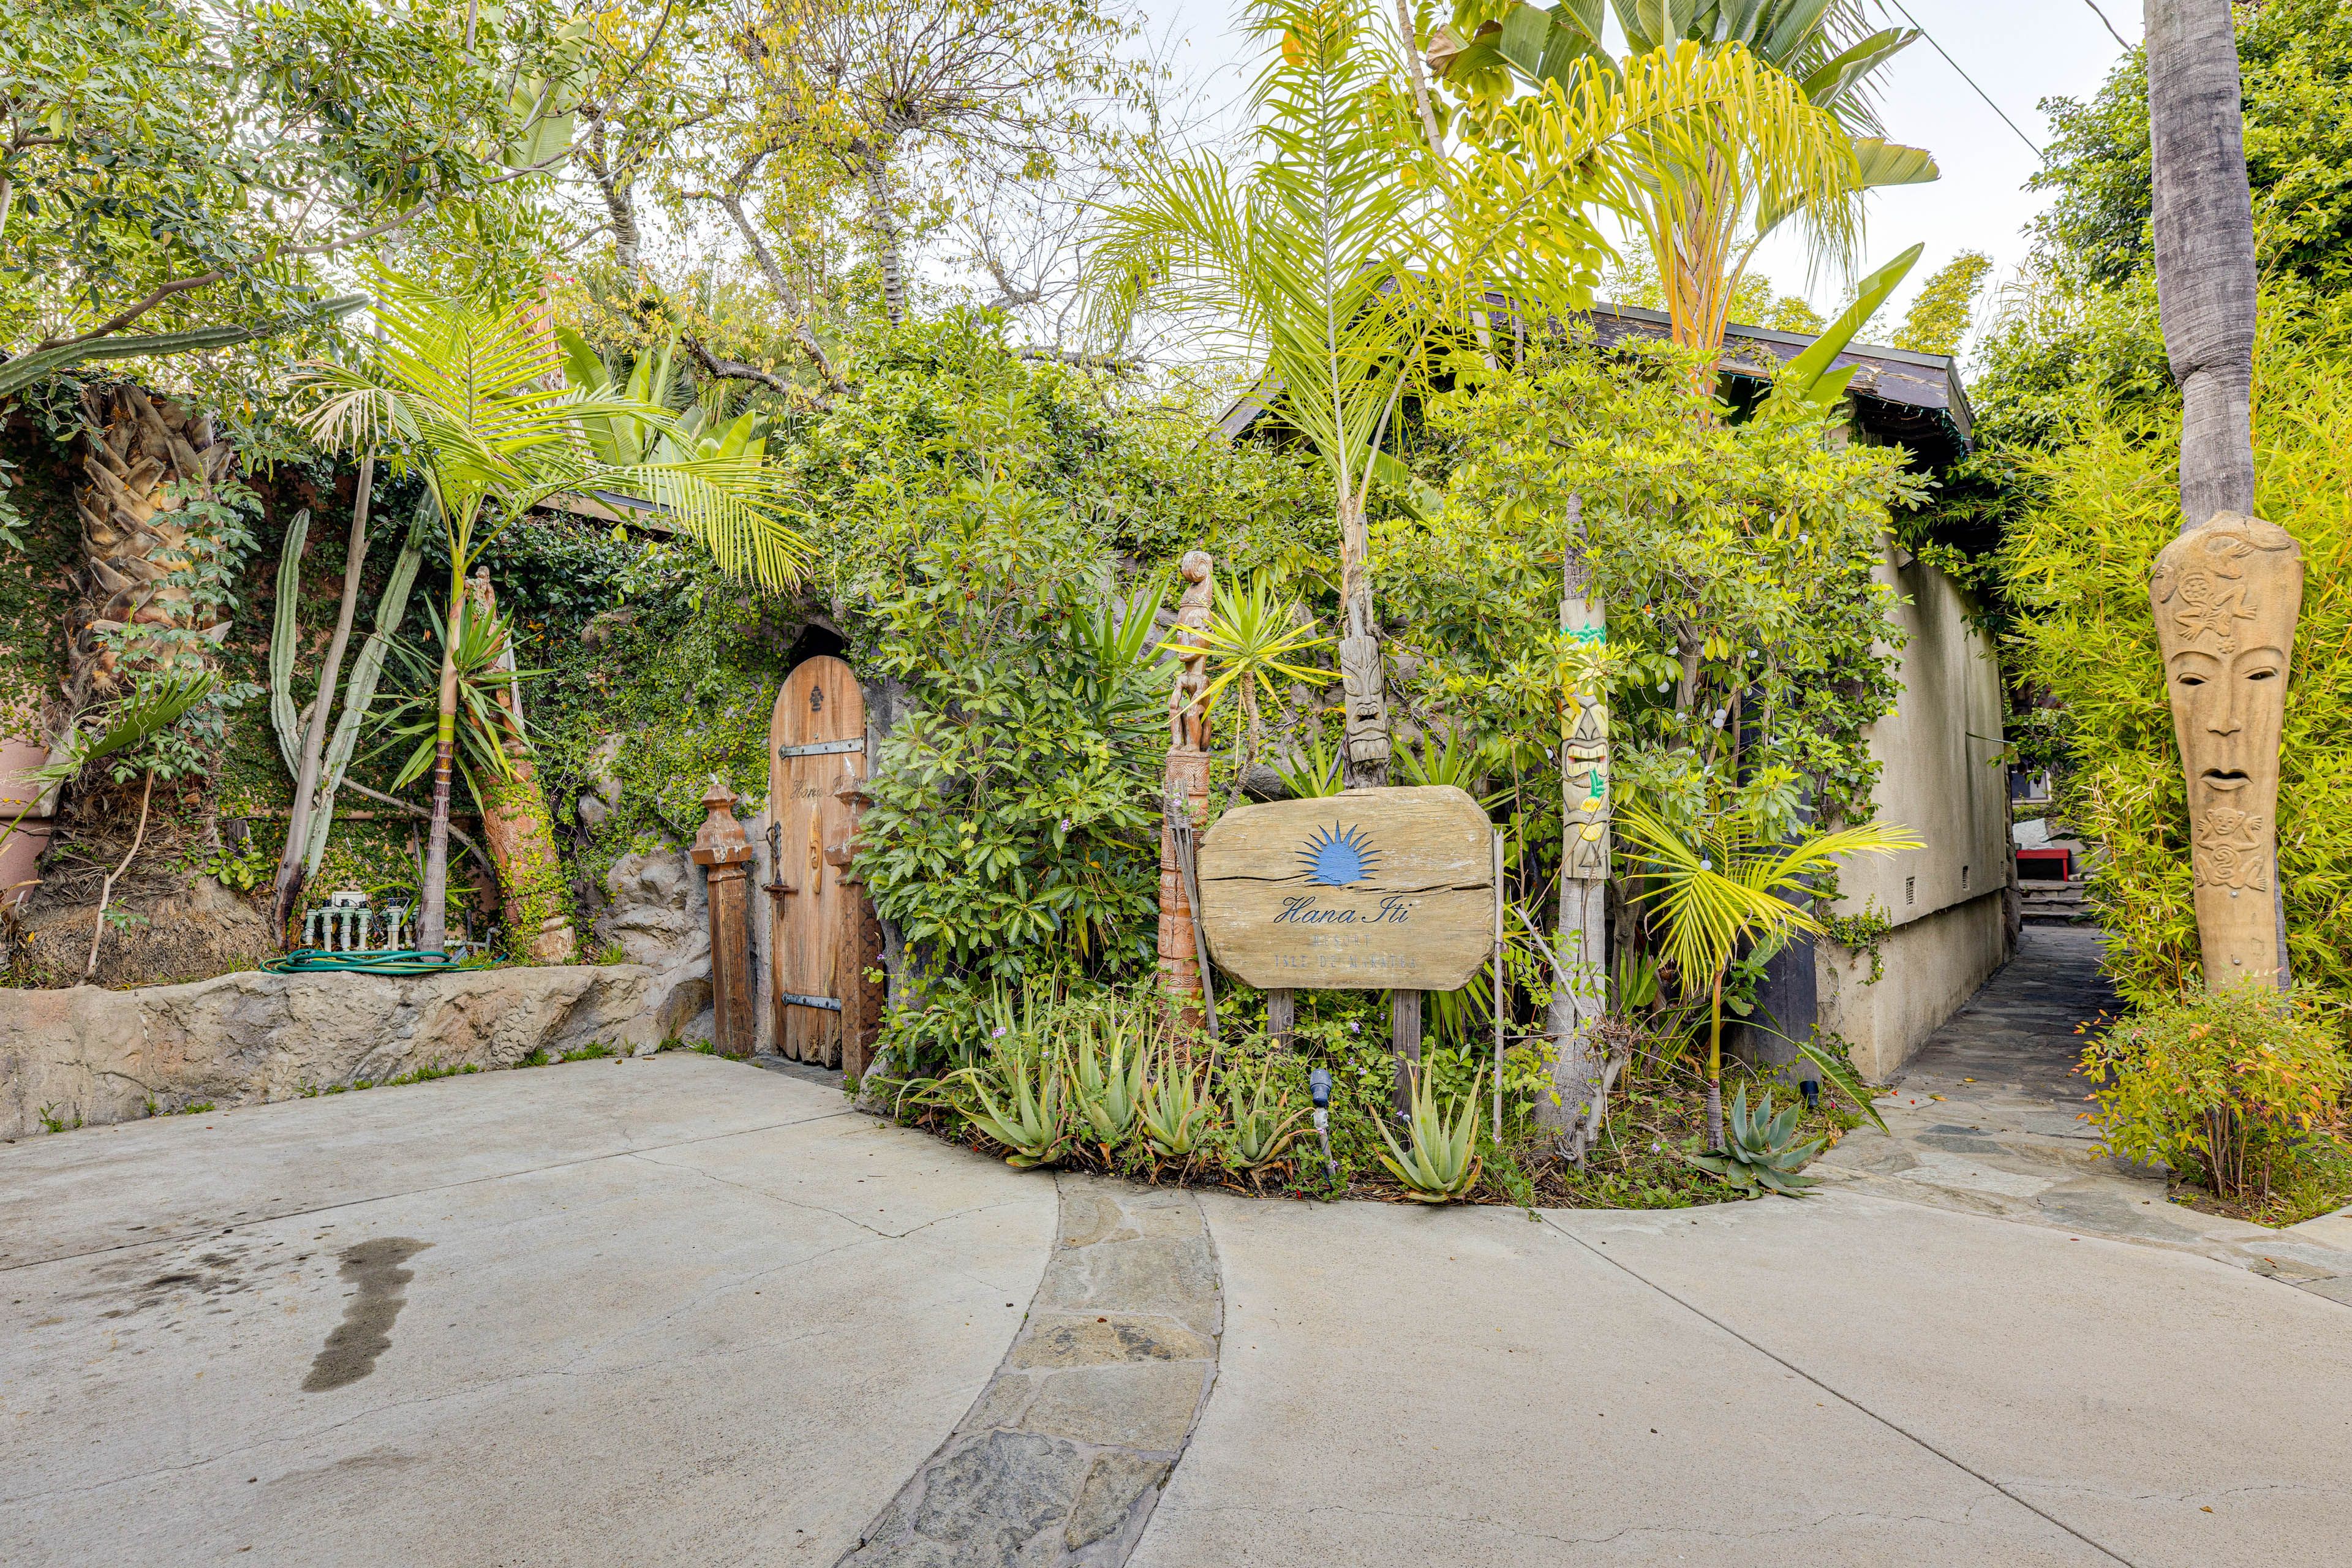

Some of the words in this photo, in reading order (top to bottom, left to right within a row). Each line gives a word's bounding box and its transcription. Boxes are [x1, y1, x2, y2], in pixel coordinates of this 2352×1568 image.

[1273, 896, 1356, 923] Hana
[1361, 895, 1412, 923] Iti
[1313, 934, 1371, 947] RESORT
[1275, 955, 1308, 968] ISLE
[1320, 955, 1336, 968] DE
